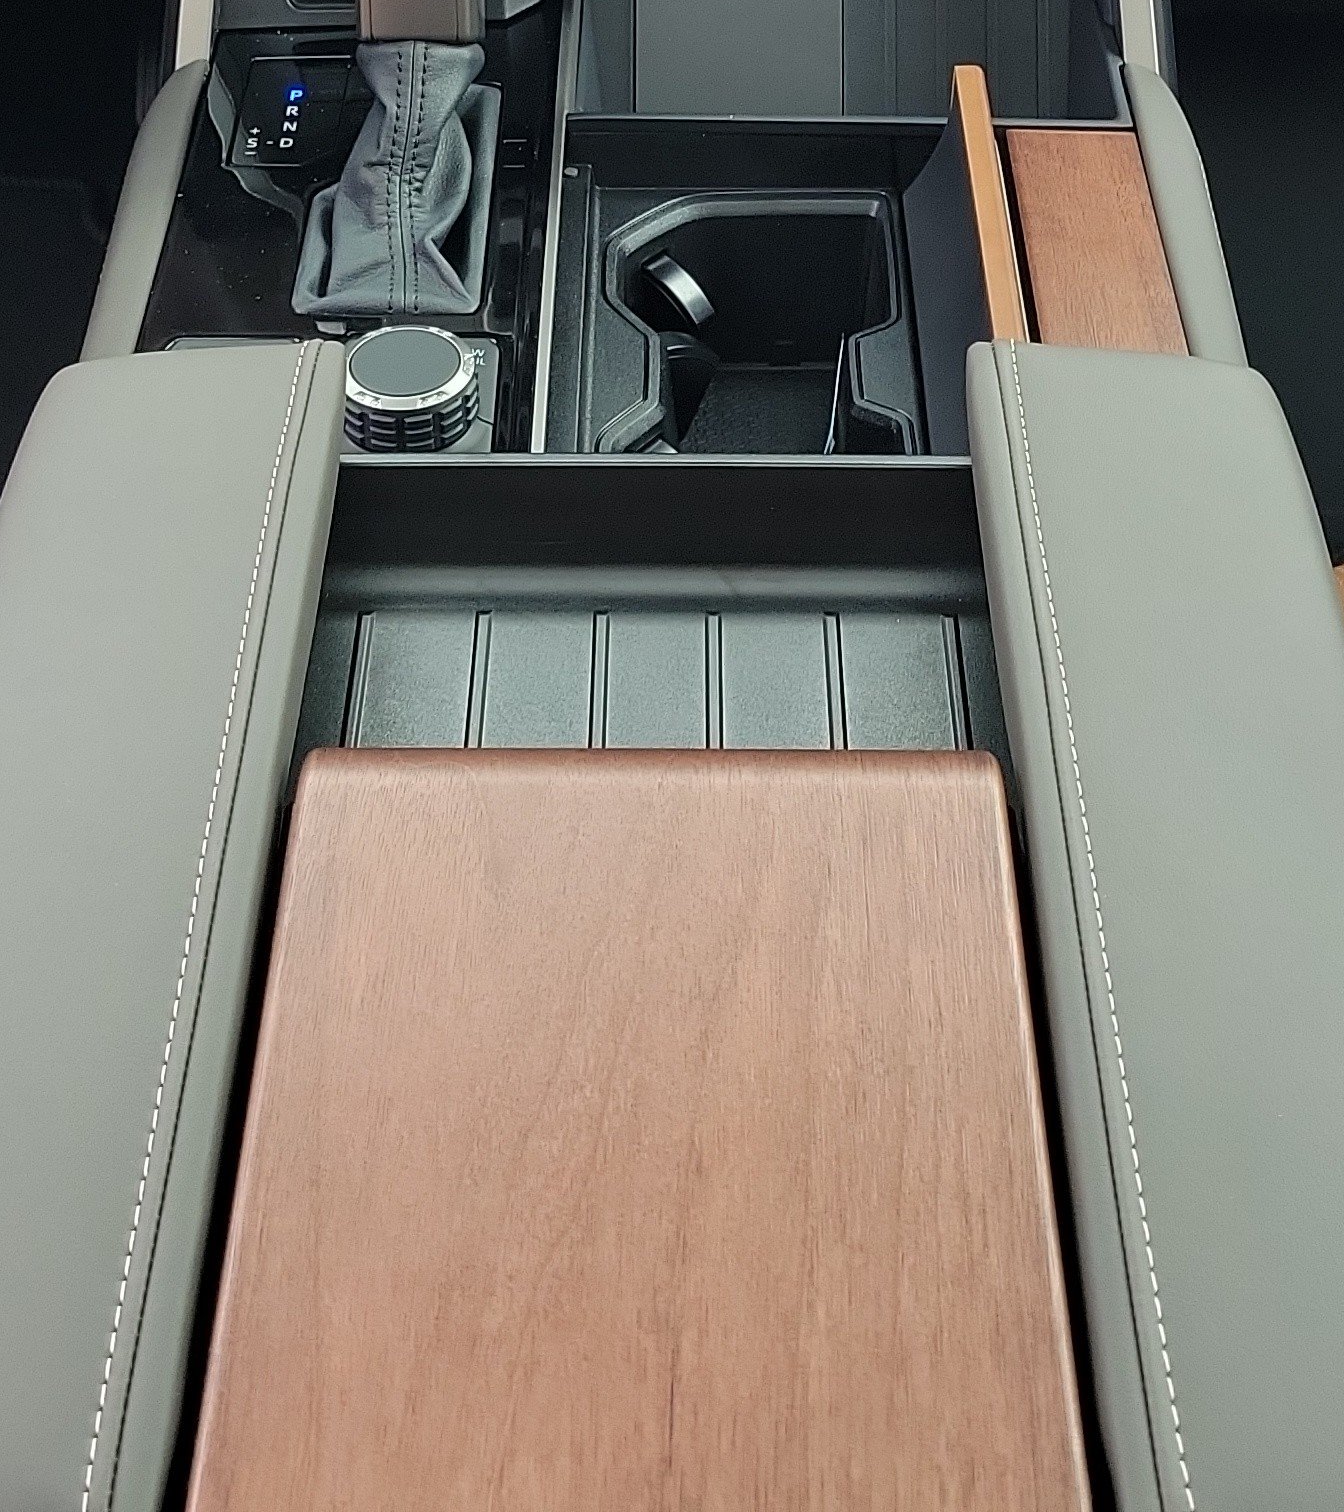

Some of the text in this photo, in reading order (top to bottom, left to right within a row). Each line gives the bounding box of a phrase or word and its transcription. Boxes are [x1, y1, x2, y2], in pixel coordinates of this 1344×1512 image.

[290, 90, 303, 101] P
[286, 105, 299, 116] R
[283, 121, 297, 132] N
[279, 137, 293, 148] D
